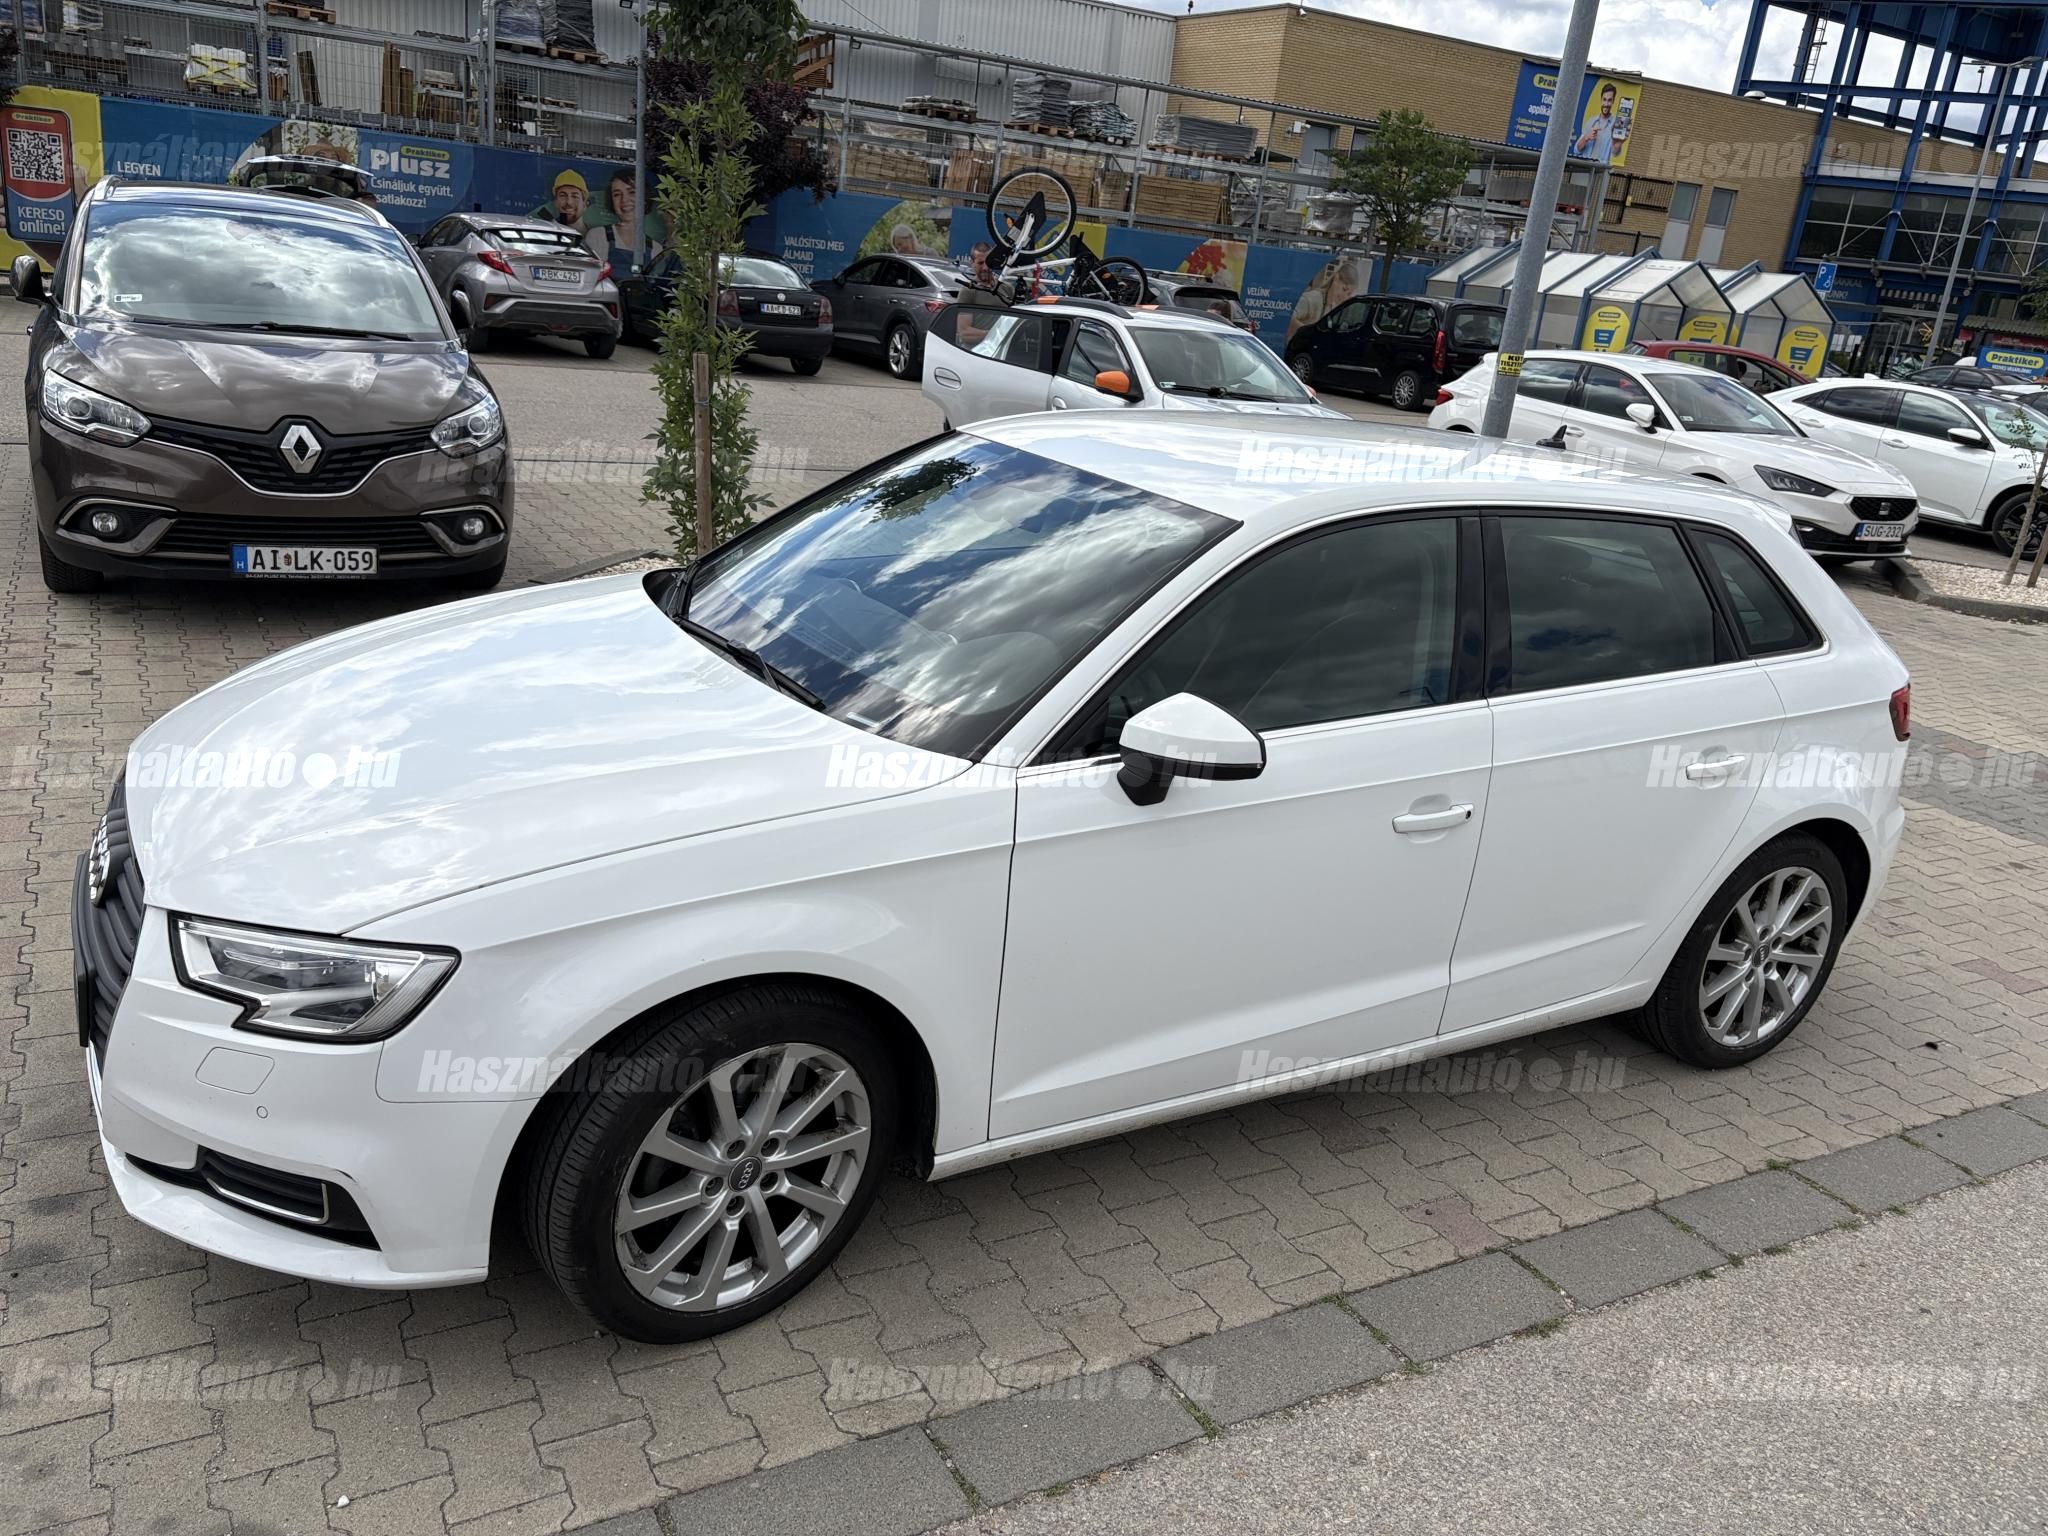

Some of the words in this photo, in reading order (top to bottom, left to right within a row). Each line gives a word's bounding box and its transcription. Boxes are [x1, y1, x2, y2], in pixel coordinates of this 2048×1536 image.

[1538, 76, 1558, 88] Prak
[117, 160, 161, 177] LEGYEN
[370, 149, 450, 179] Plusz
[370, 177, 416, 193] Csináljuk
[418, 184, 454, 198] együtt,
[17, 206, 65, 221] KERESD
[19, 220, 66, 236] online!
[827, 240, 845, 252] MEG
[782, 247, 814, 261] ÁLMAID
[541, 269, 578, 281] RBK-425
[1818, 266, 1827, 278] P
[1247, 286, 1270, 297] VELÜNK
[1991, 353, 2040, 367] Praktiker
[1864, 525, 1902, 538] SUG-232
[236, 560, 245, 569] H
